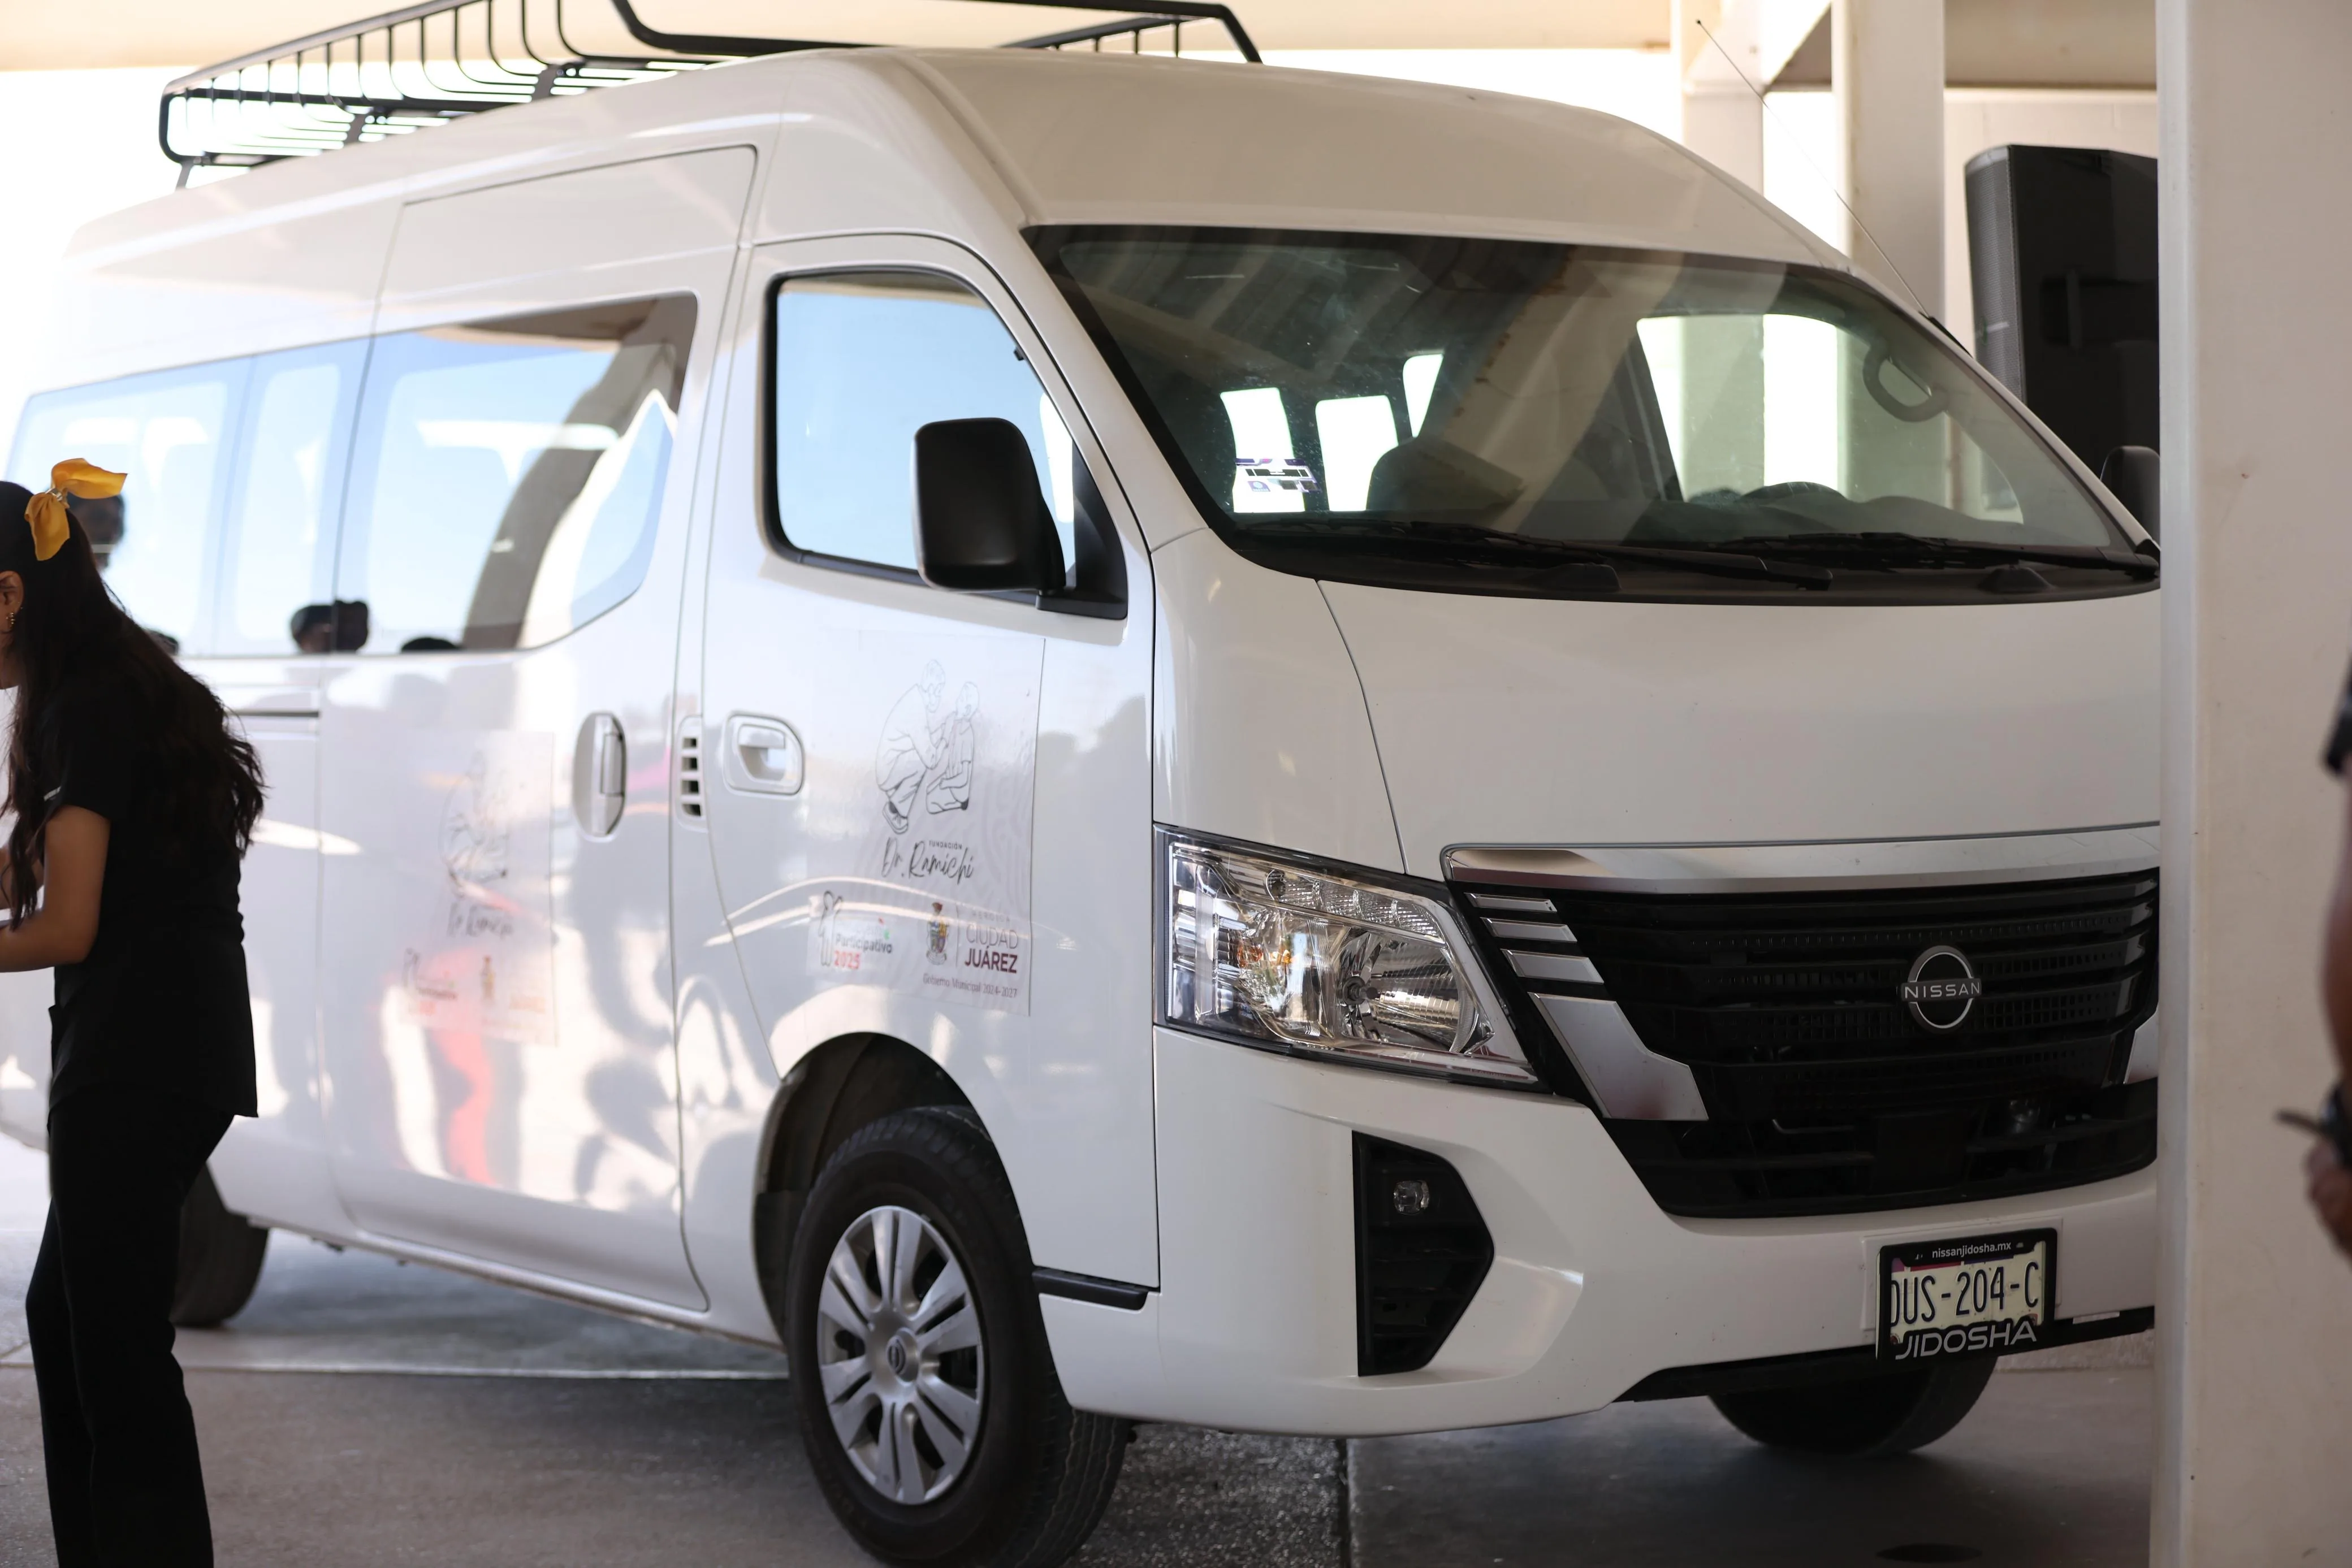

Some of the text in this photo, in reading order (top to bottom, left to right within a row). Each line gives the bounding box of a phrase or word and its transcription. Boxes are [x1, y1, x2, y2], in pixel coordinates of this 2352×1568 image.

[928, 840, 962, 850] FUNDACIÓN
[881, 837, 974, 885] Dr. Ramichi
[836, 932, 893, 954] Participativo
[966, 923, 1019, 949] CIUDAD
[834, 950, 861, 970] 2025
[964, 945, 1018, 974] JUÁREZ
[923, 972, 1018, 998] Gobierno Municipal 2024-2027
[1905, 982, 1979, 998] NISSAN
[1931, 1242, 2012, 1258] nissanjidosha.mx
[1895, 1320, 2037, 1360] JIDOSHA
